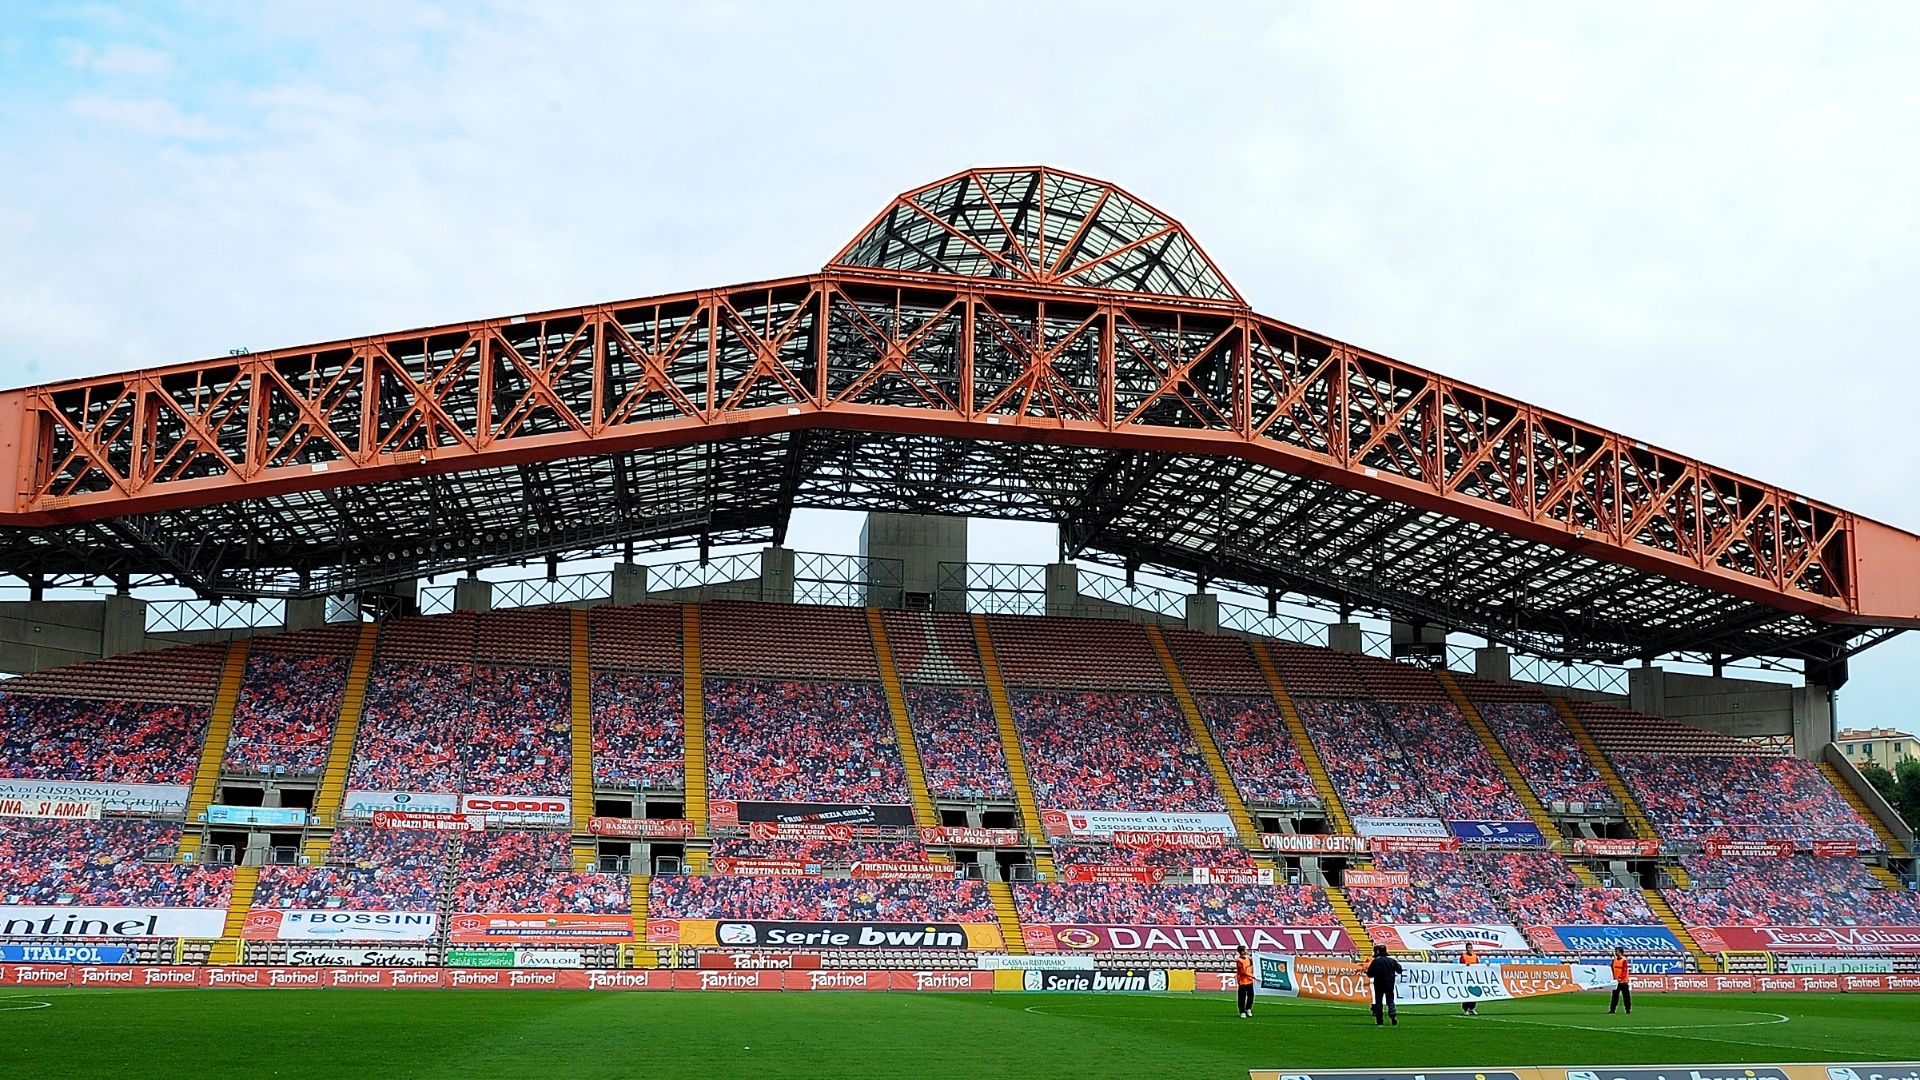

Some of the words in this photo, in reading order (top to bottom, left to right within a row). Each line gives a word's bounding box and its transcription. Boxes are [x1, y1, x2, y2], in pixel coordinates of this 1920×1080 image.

[36, 787, 130, 796] RISPARMIO
[38, 802, 51, 815] SI
[54, 803, 90, 817] AMA!
[810, 812, 842, 820] VENEZIA
[843, 808, 870, 816] GIULIA
[392, 820, 420, 829] RAGAZZI
[423, 820, 436, 829] DEL
[437, 821, 469, 830] MURETTO
[935, 836, 1004, 844] ALABARDAE
[1115, 834, 1149, 845] MILANO
[1164, 834, 1221, 846] ALABARDATA
[1210, 874, 1225, 884] BAR
[1229, 874, 1257, 884] JUNIOR
[3, 914, 158, 935] ntinel
[310, 914, 431, 924] BOSSINI
[766, 930, 849, 945] Serie
[858, 927, 962, 946] bwin
[1107, 928, 1286, 950] DAHLIA
[1283, 930, 1341, 950] TV
[1420, 928, 1499, 942] sterilgarda
[1568, 936, 1674, 945] PALMANOVA
[1753, 927, 1824, 944] Testa
[23, 947, 101, 960] ITALPOL
[729, 954, 792, 969] Fantinel
[1262, 961, 1278, 971] FAI
[1296, 964, 1325, 974] MANDA
[1841, 963, 1887, 973] Delizia
[13, 967, 68, 983] Fantinel
[78, 968, 132, 984] Fantinel
[142, 969, 195, 984] Fantinel
[205, 969, 258, 985] Fantinel
[267, 969, 318, 985] Fantinel
[330, 970, 380, 986] Fantinel
[389, 970, 439, 986] Fantinel
[449, 971, 498, 986] Fantinel
[507, 971, 556, 986] Fantinel
[584, 970, 648, 990] Fantinel
[696, 970, 759, 990] Fantinel
[806, 971, 867, 990] Fantinel
[913, 972, 972, 991] Fantinel
[1047, 975, 1088, 990] Serie
[1092, 970, 1145, 990] bwin
[1399, 969, 1434, 984] ENDI
[1441, 970, 1500, 984] L'ITALIA
[1503, 971, 1530, 979] MANDA
[1530, 971, 1542, 979] UN
[1301, 974, 1368, 998] 45504
[1629, 976, 1662, 990] Fantinel
[1671, 976, 1708, 990] Fantinel
[1714, 977, 1751, 991] Fantinel
[1758, 978, 1795, 991] Fantinel
[1800, 978, 1837, 991] Fantinel
[1846, 976, 1880, 990] Fantinel
[1409, 985, 1440, 1000] TUO
